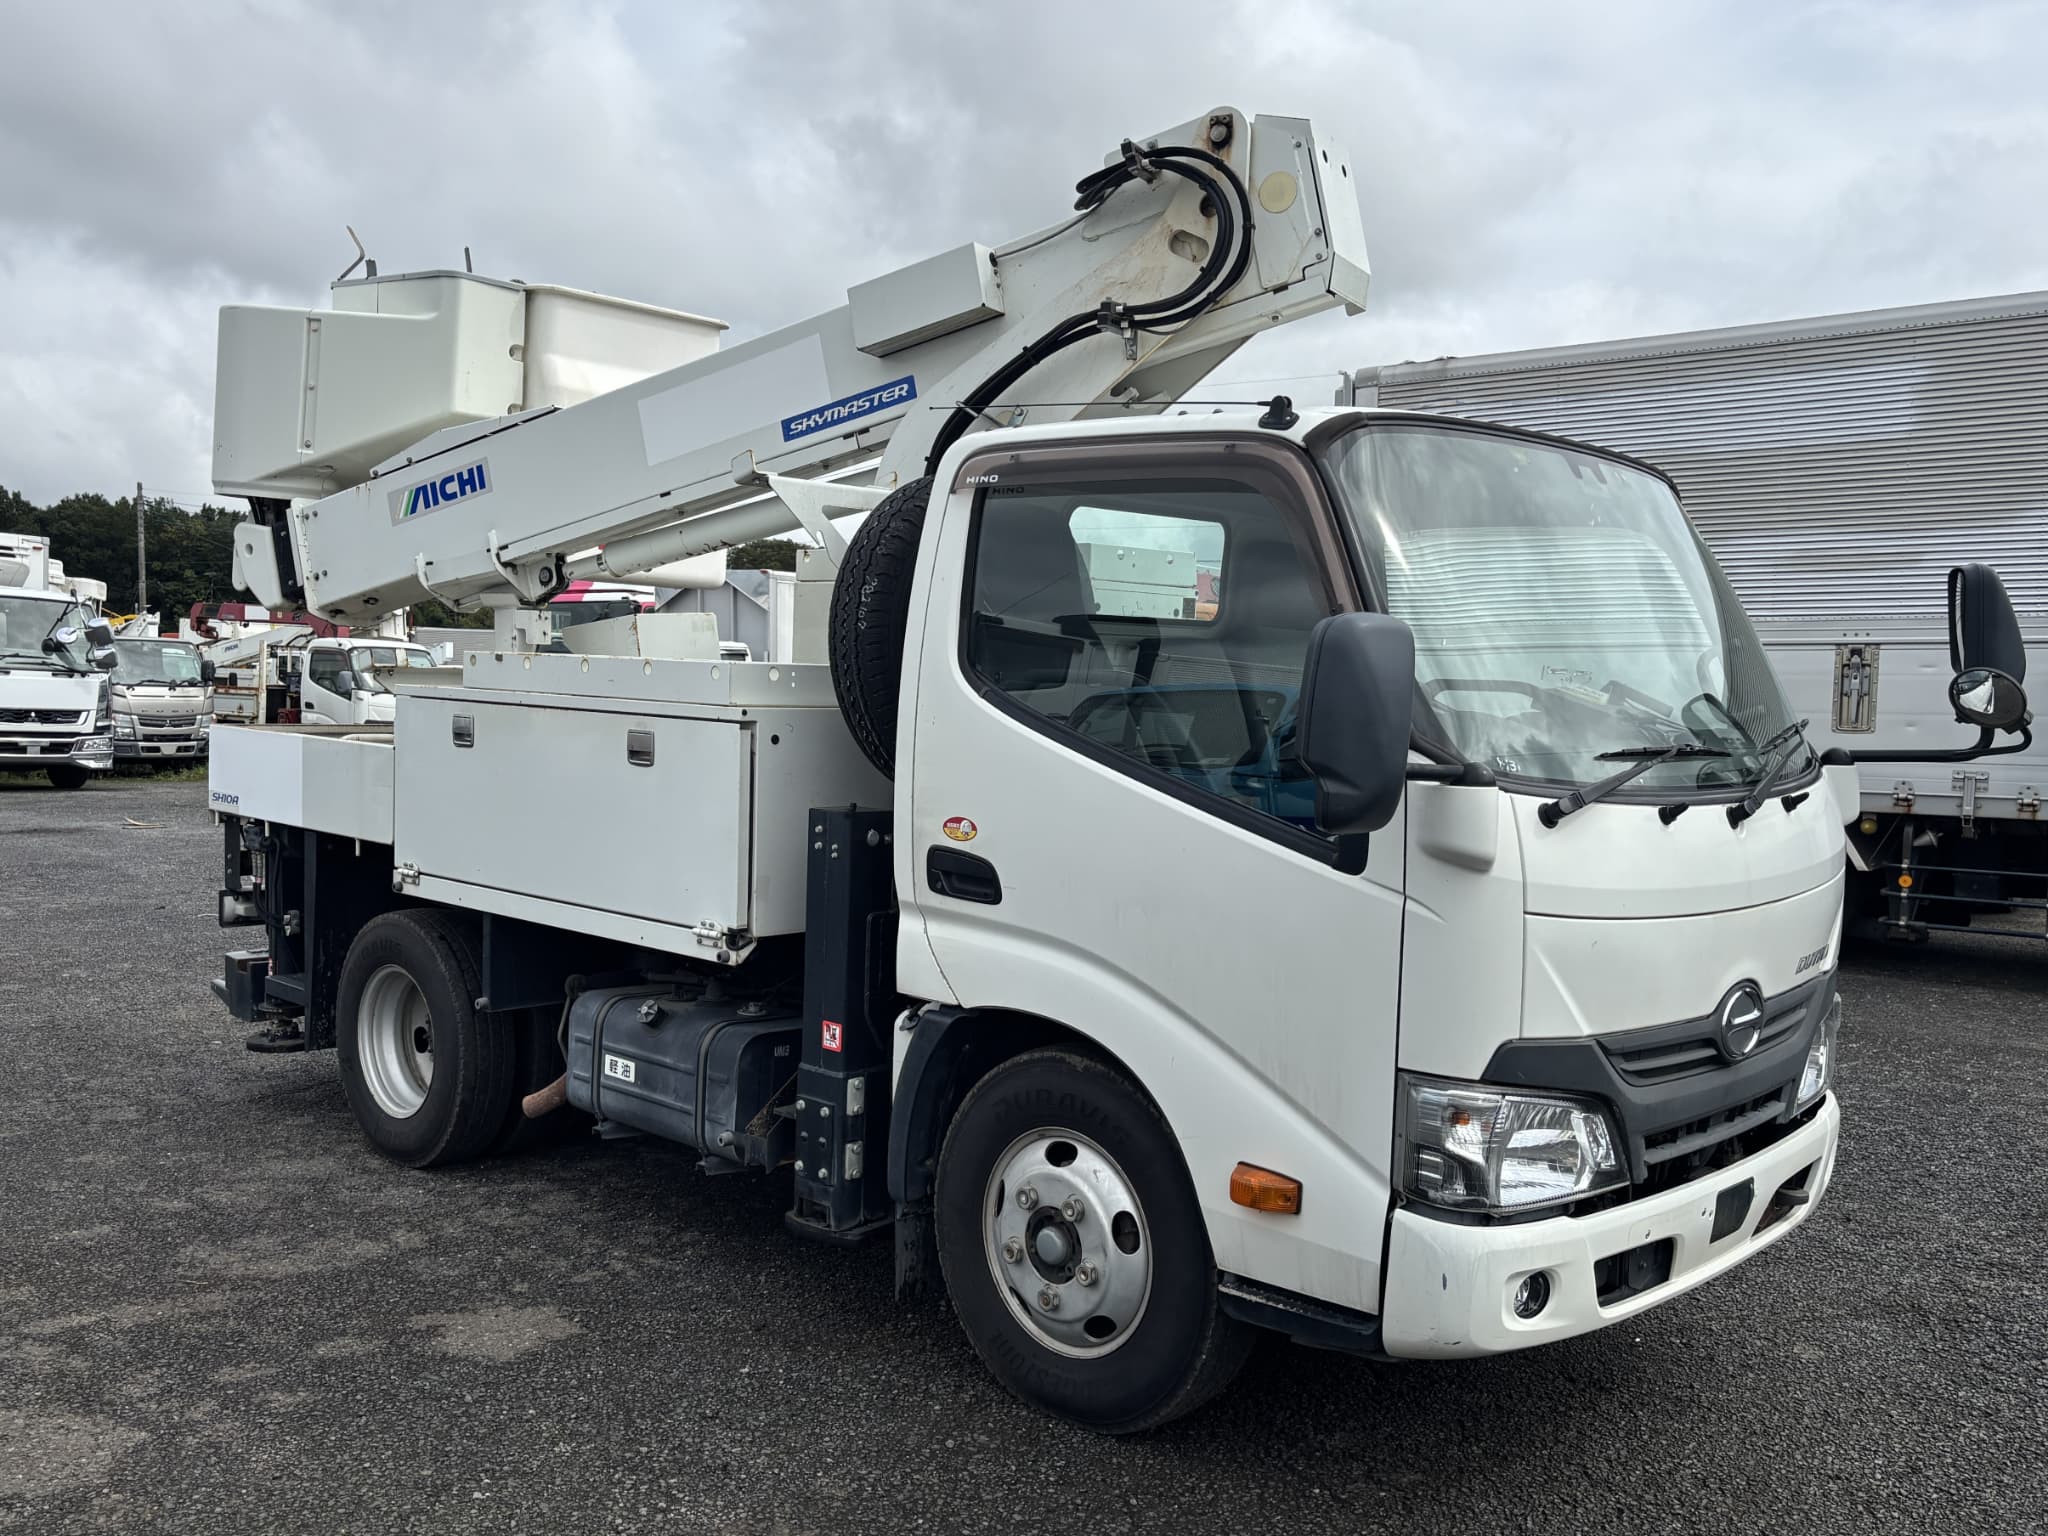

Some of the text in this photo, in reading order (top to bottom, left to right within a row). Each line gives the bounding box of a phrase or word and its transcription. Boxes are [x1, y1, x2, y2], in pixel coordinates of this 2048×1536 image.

[788, 383, 909, 435] SKYMASTER
[409, 463, 486, 515] AICHI
[966, 474, 999, 484] HINO
[609, 1058, 631, 1078] 軽油
